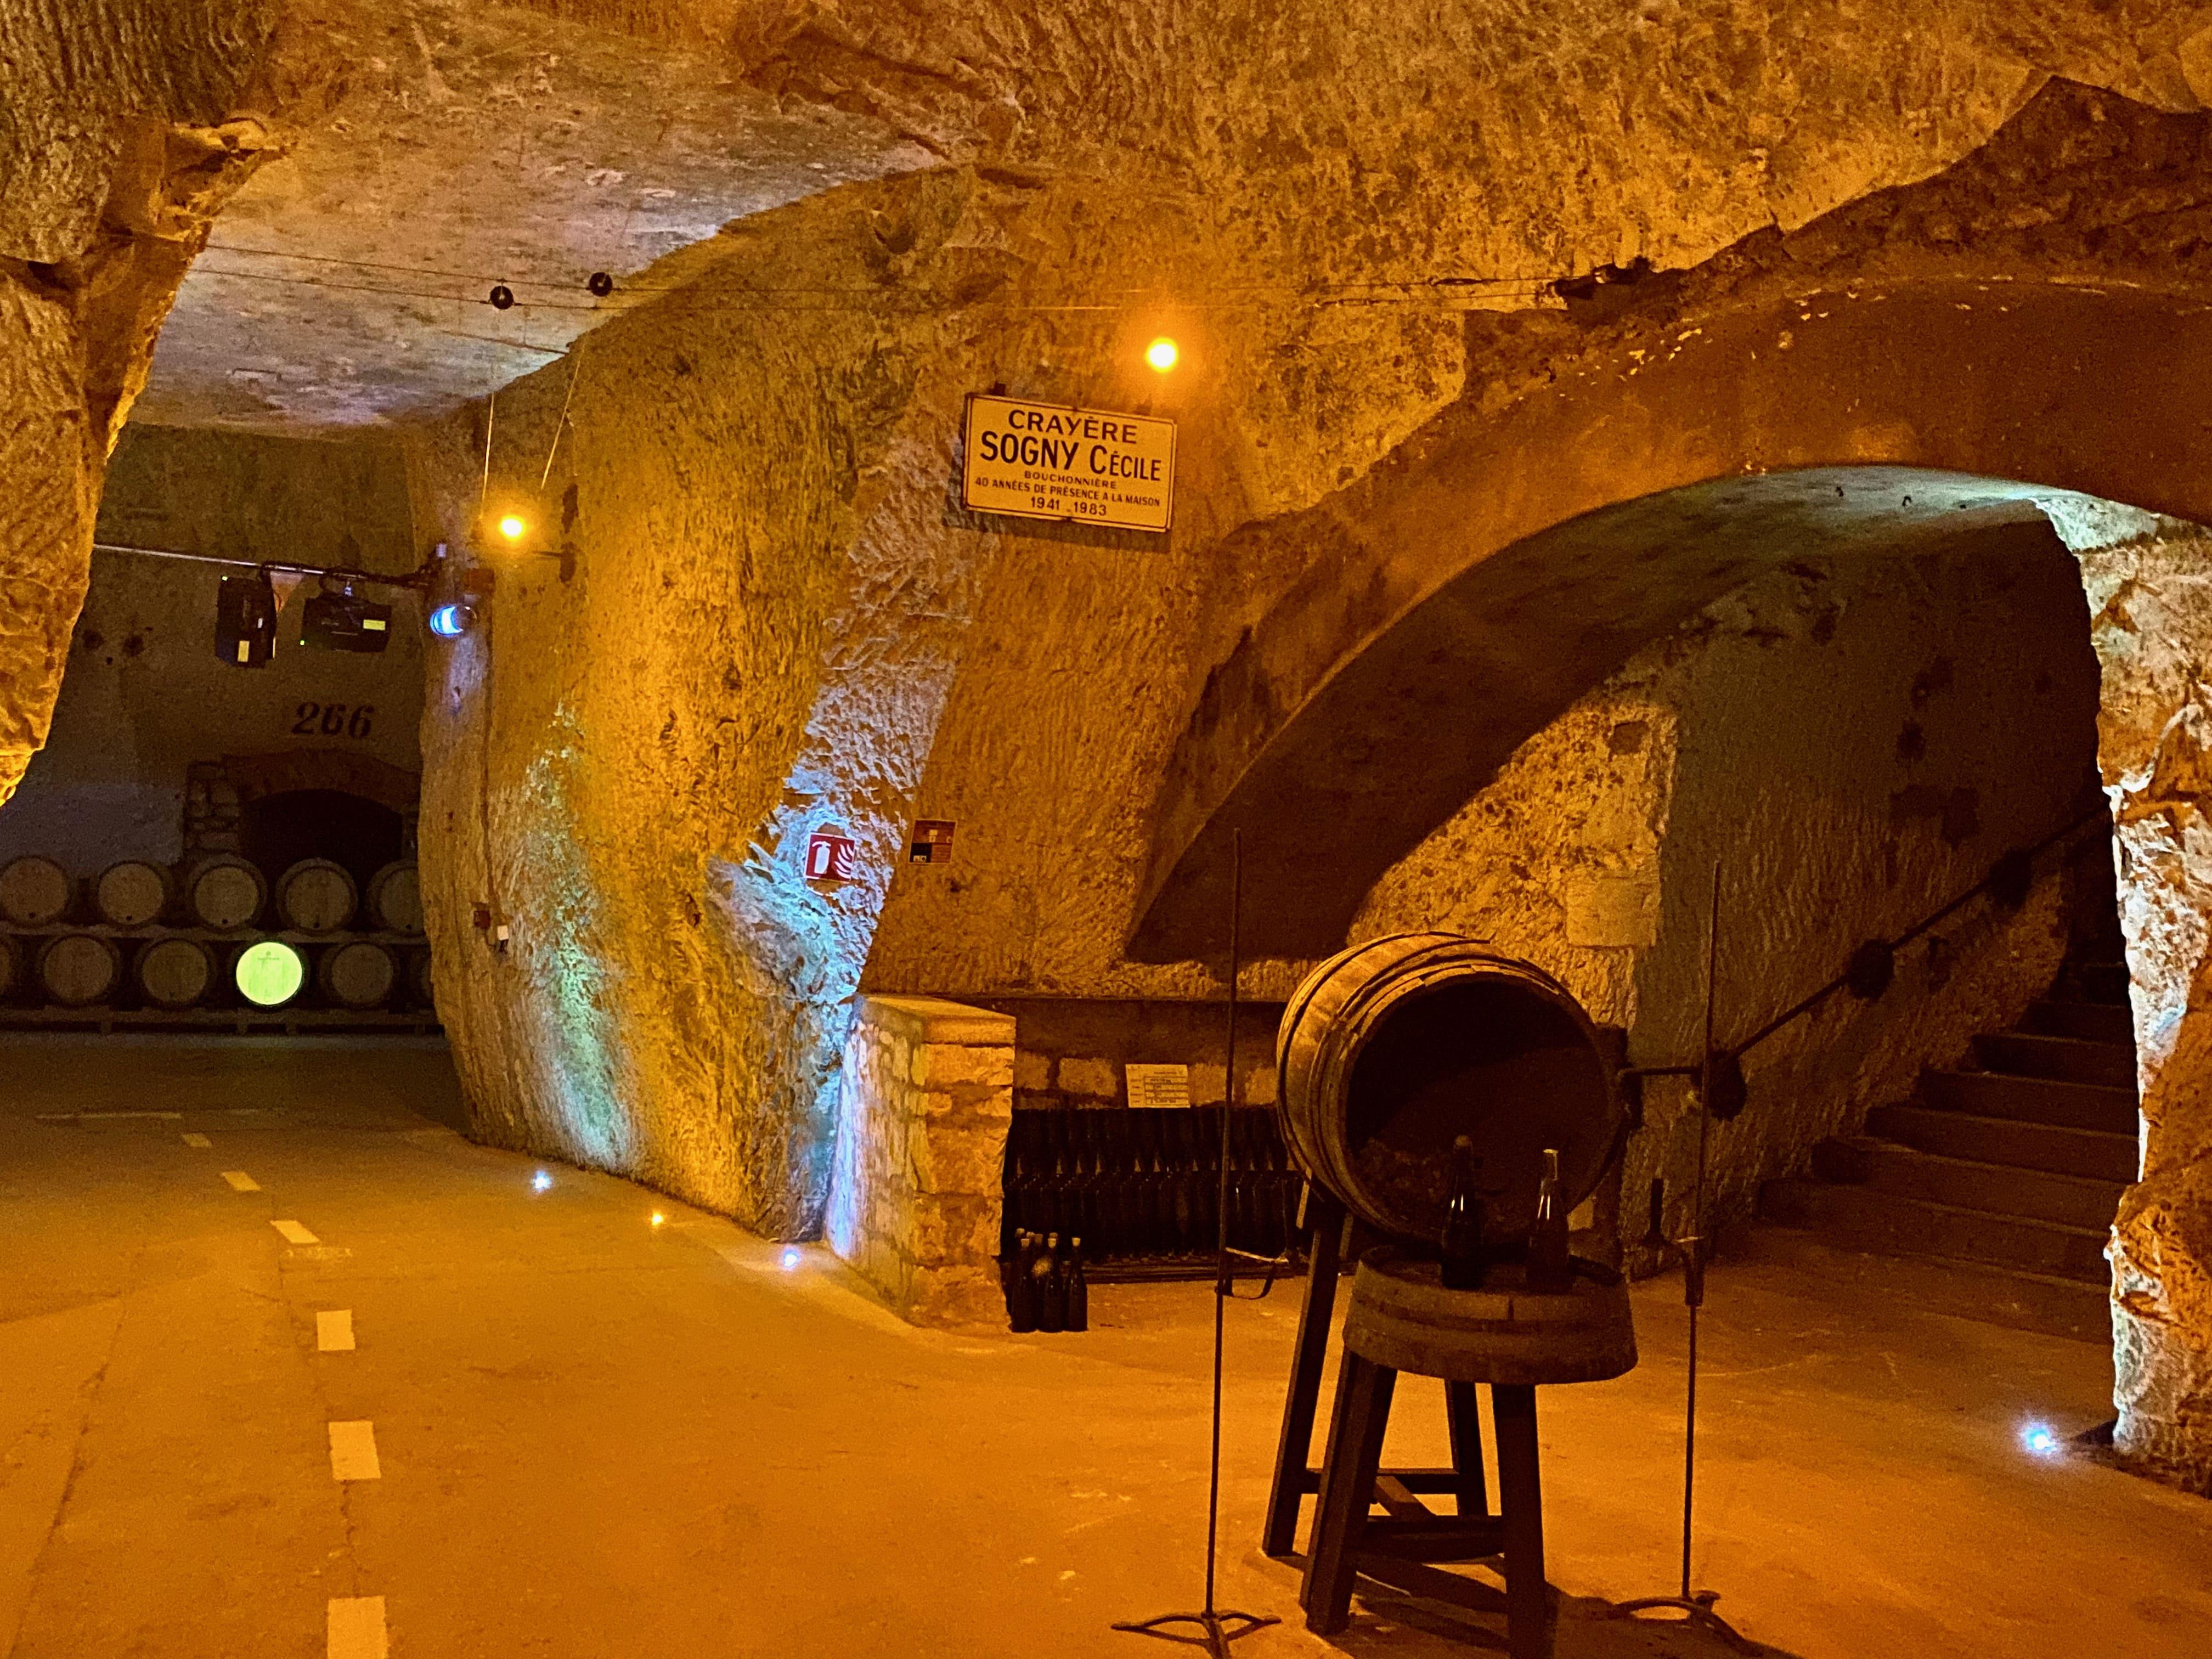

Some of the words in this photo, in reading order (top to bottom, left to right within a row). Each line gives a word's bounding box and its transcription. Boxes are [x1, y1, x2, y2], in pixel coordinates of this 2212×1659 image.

[1008, 410, 1137, 444] CRAYÈRE
[980, 431, 1079, 470] SOGNY
[1090, 445, 1161, 481] CÉCILE
[975, 477, 989, 487] 40
[992, 479, 1030, 492] ANNÉES
[1034, 483, 1046, 494] DE
[1111, 493, 1122, 503] LA
[1125, 495, 1160, 506] MAISON
[1024, 471, 1116, 489] BOUCHONNIÈRE
[1031, 496, 1059, 511] 1941
[1074, 501, 1107, 516] 1983
[291, 702, 375, 738] 266
